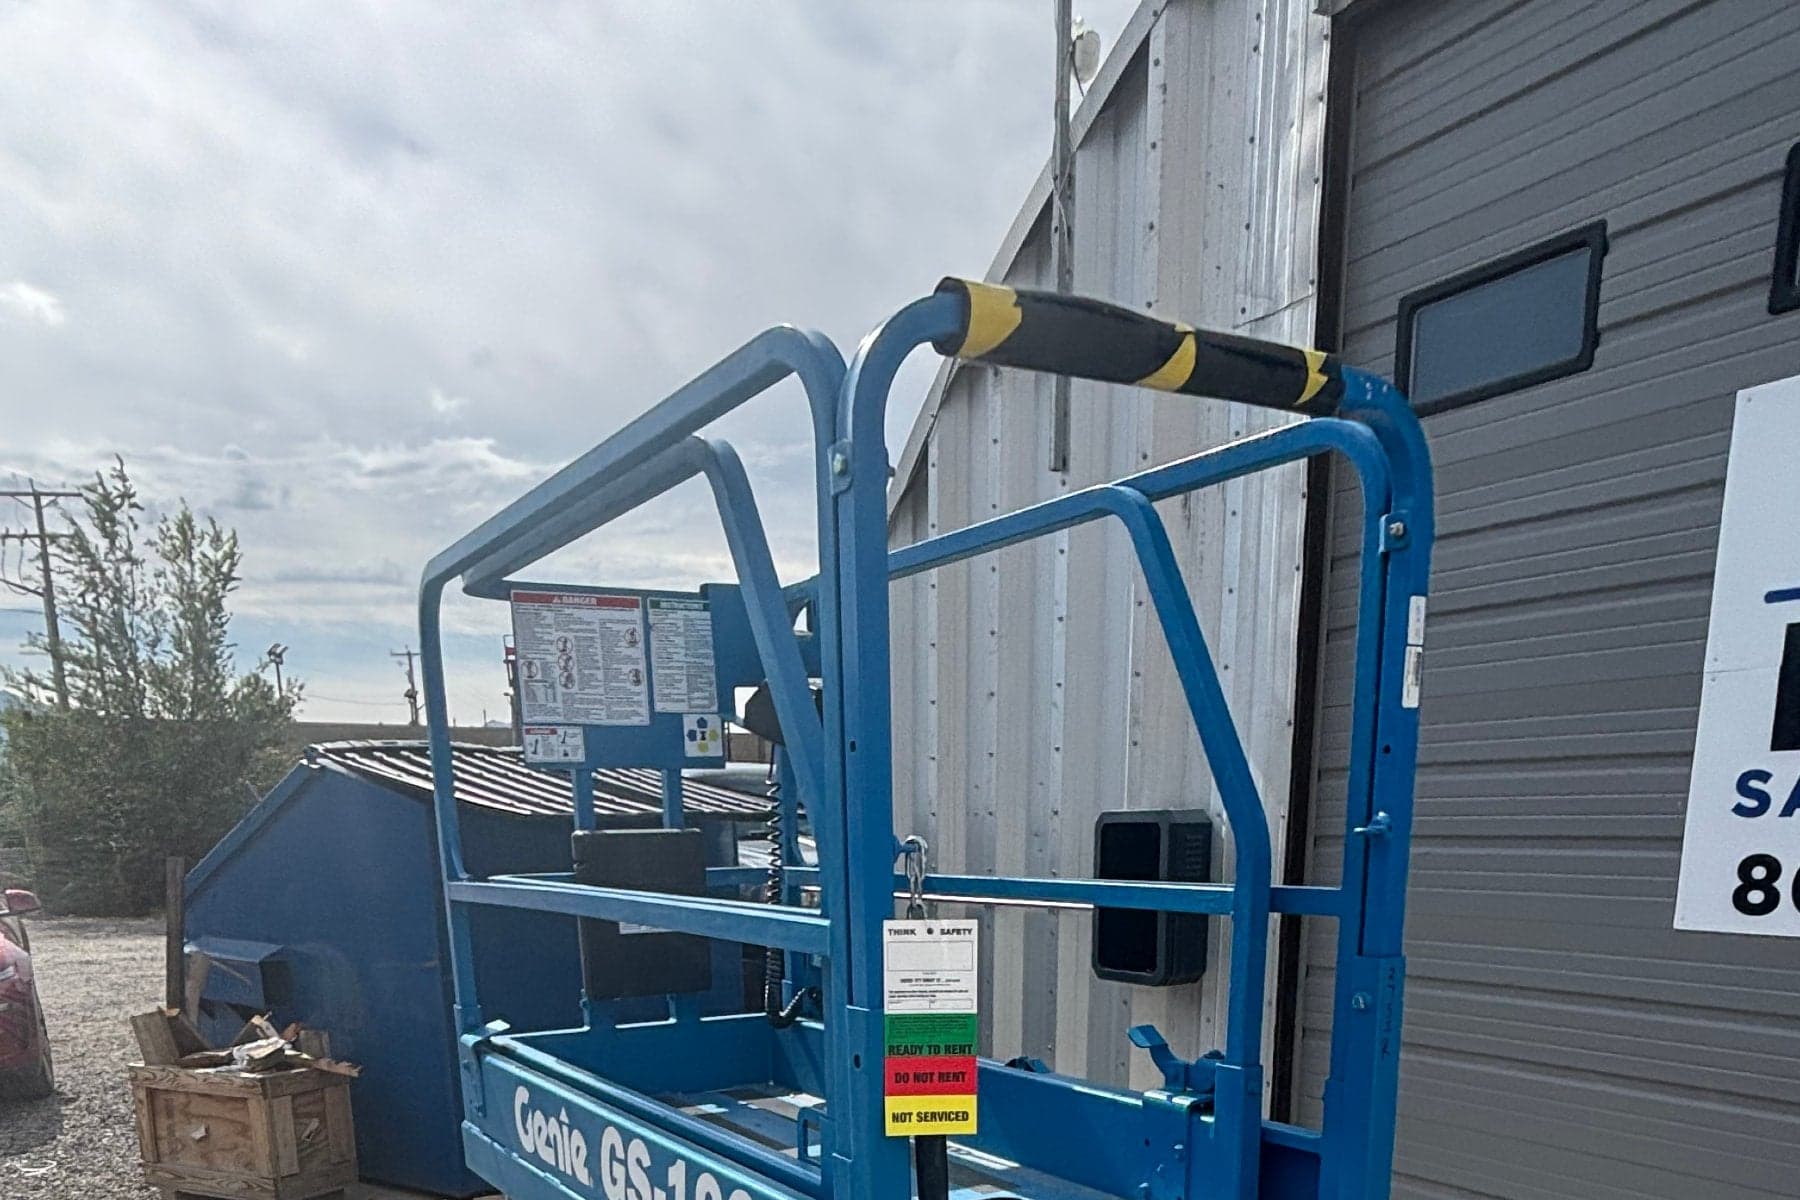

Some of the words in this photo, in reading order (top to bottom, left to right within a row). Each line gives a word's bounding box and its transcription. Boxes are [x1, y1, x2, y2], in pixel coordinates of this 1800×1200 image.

[1732, 853, 1800, 917] 8
[888, 928, 917, 936] THINK
[940, 927, 973, 936] SAFETY
[888, 1044, 924, 1056] READY
[927, 1044, 941, 1055] TO
[944, 1043, 973, 1055] RENT
[894, 1072, 909, 1084] DO
[913, 1071, 934, 1083] NOT
[938, 1070, 967, 1083] RENT
[892, 1112, 913, 1123] NOT
[916, 1110, 969, 1123] SERVICED
[514, 1085, 591, 1188] Genie
